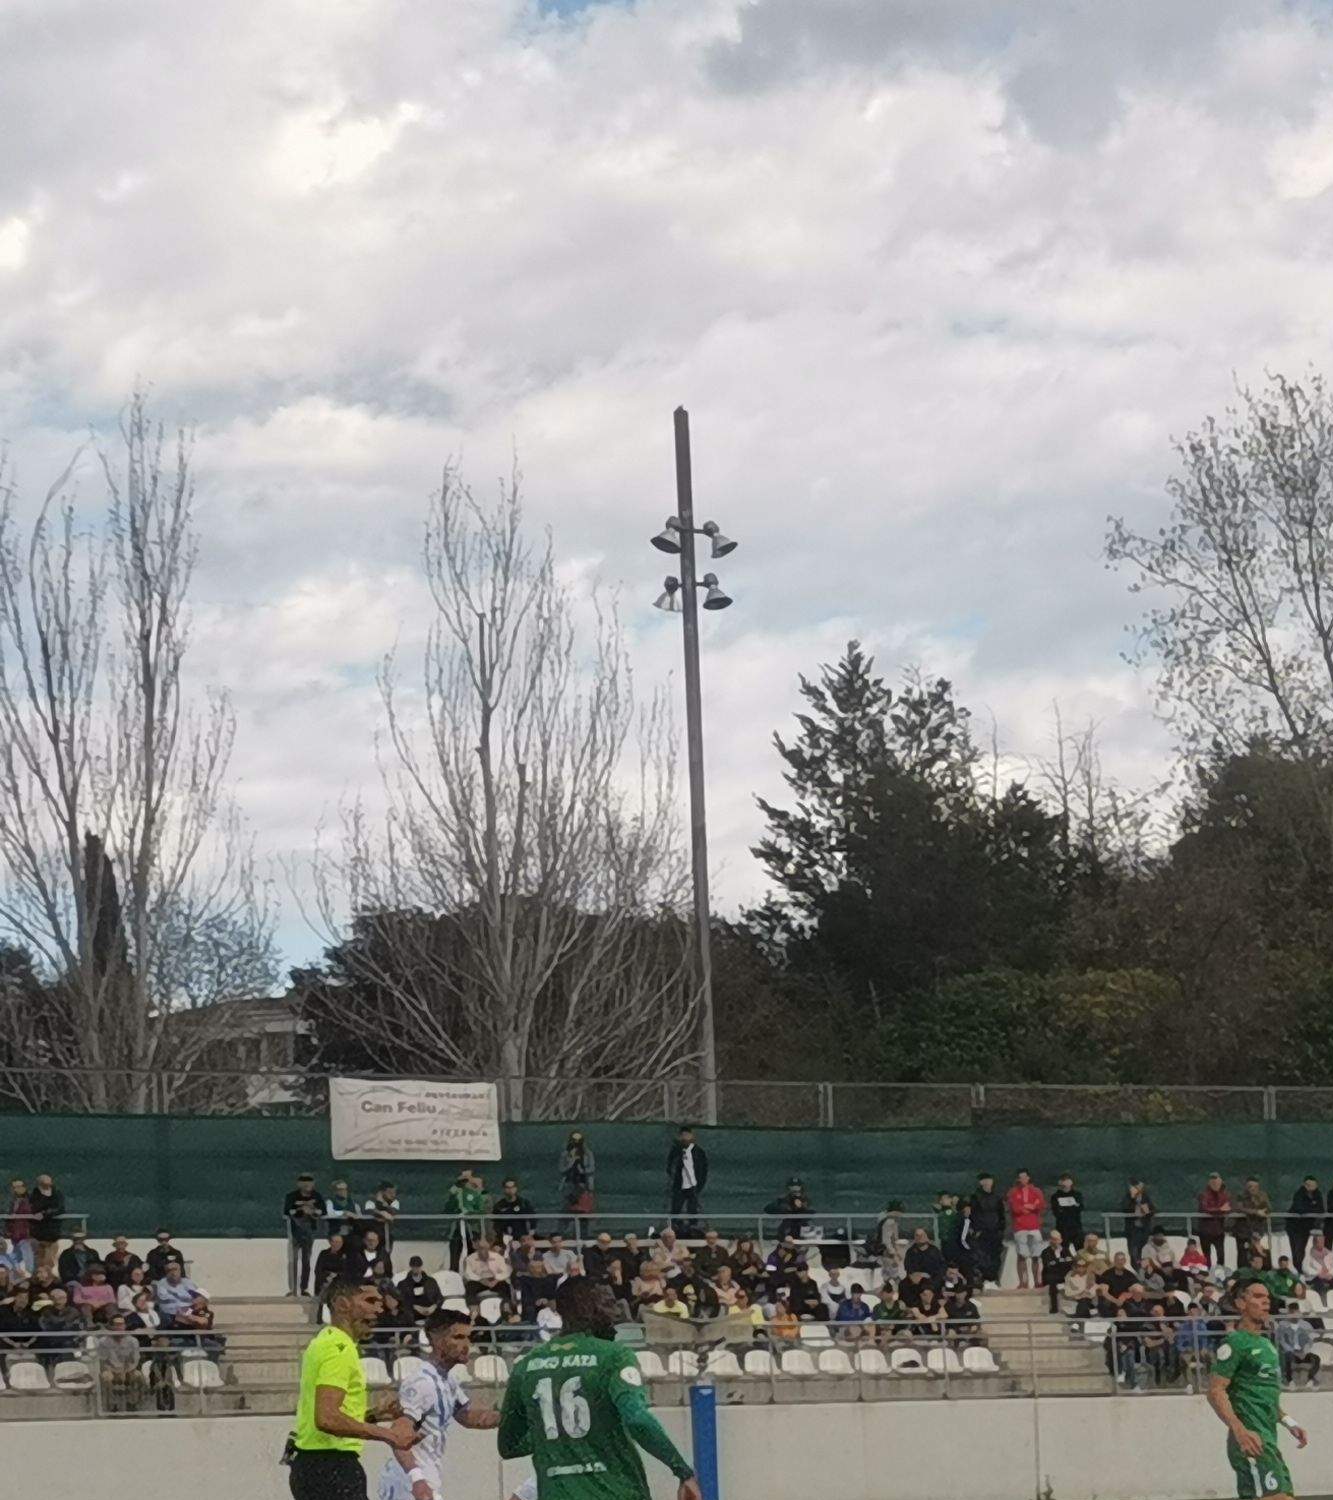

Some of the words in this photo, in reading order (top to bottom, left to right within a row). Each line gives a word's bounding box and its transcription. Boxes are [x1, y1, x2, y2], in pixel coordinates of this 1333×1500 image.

[360, 1100, 393, 1114] Can
[397, 1101, 437, 1114] Feliu
[532, 1376, 591, 1439] 16
[1264, 1470, 1278, 1490] 6
